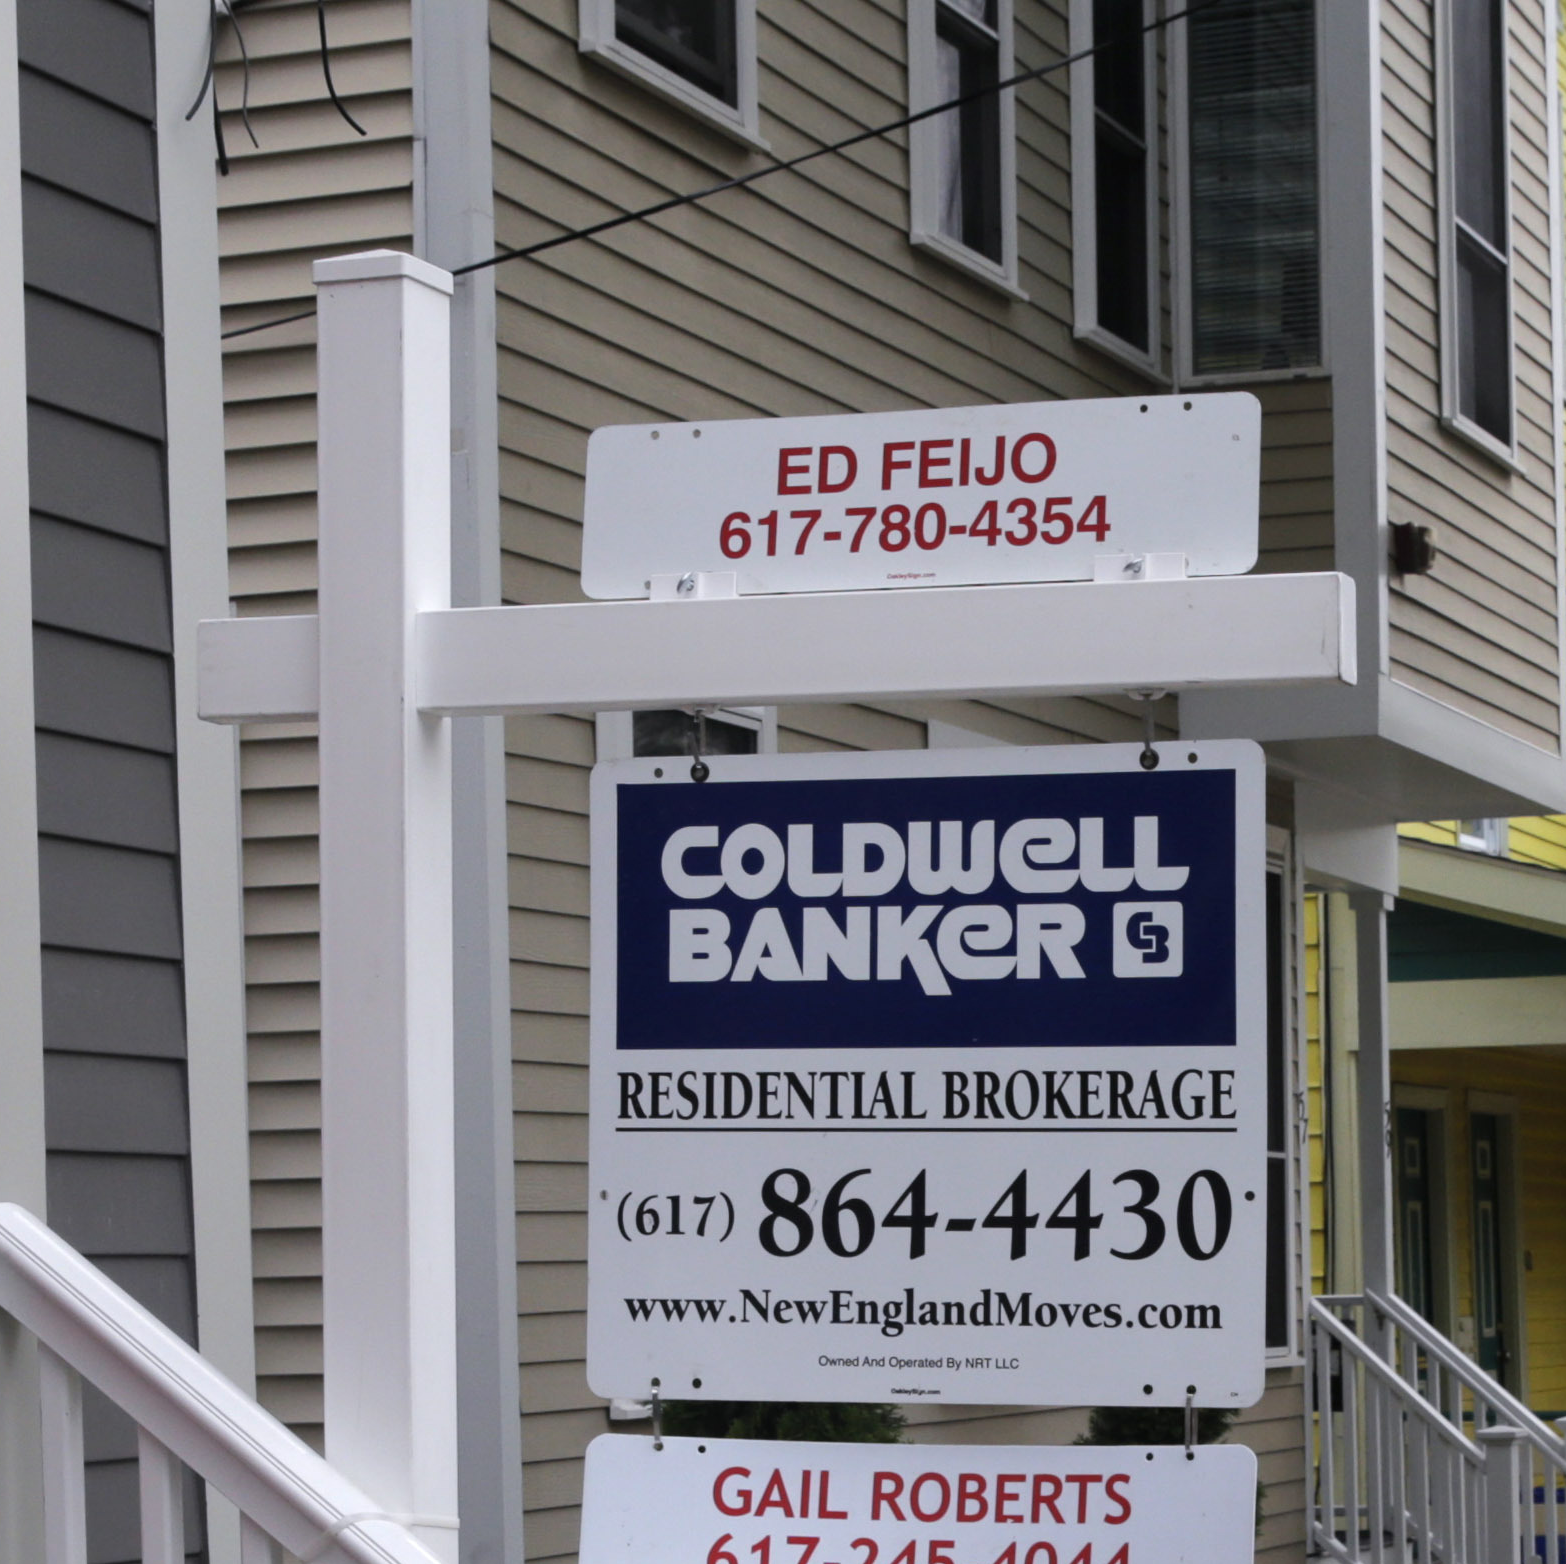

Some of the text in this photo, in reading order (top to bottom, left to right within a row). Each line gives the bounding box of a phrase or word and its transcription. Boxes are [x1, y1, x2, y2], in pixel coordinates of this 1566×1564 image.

[778, 432, 1057, 496] ED FEIJO
[719, 494, 1111, 560] 617-780-4354
[661, 815, 1190, 900] COLDWELL
[669, 902, 1086, 996] BANKER
[616, 1068, 1237, 1121] RESIDENTIAL BROKERAGE
[616, 1167, 1233, 1262] (617) 864-4430
[623, 1287, 1223, 1338] www.NewEnglandMoves.com
[818, 1355, 1020, 1371] Owned And Operated By NRT LLC
[712, 1466, 1132, 1525] GAIL ROBERTS
